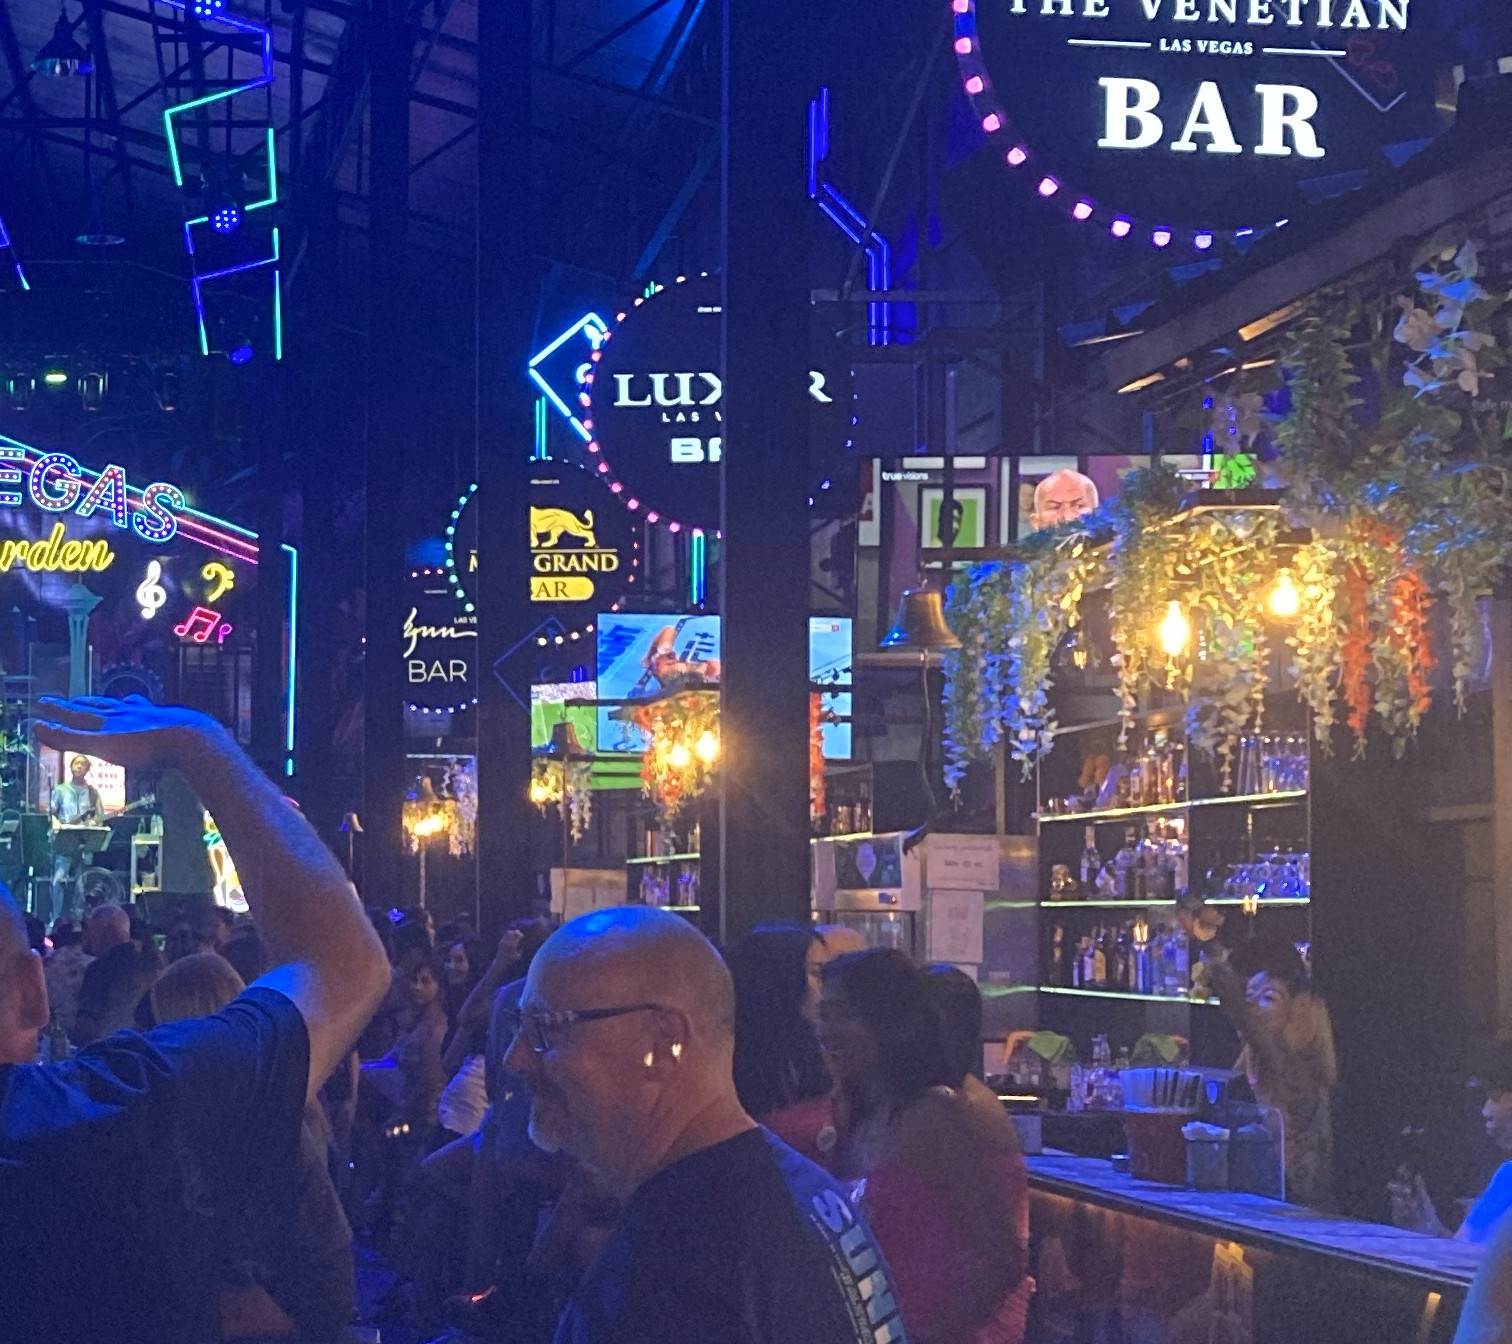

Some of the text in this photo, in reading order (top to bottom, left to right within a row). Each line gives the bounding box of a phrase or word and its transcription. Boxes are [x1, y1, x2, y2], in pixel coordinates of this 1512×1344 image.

[1159, 37, 1254, 56] LAS VEGAS
[1096, 76, 1326, 158] BAR
[612, 371, 834, 407] LUXR
[661, 411, 701, 424] LAS
[533, 553, 620, 573] GRAND
[531, 580, 571, 599] AR
[408, 659, 468, 683] BAR
